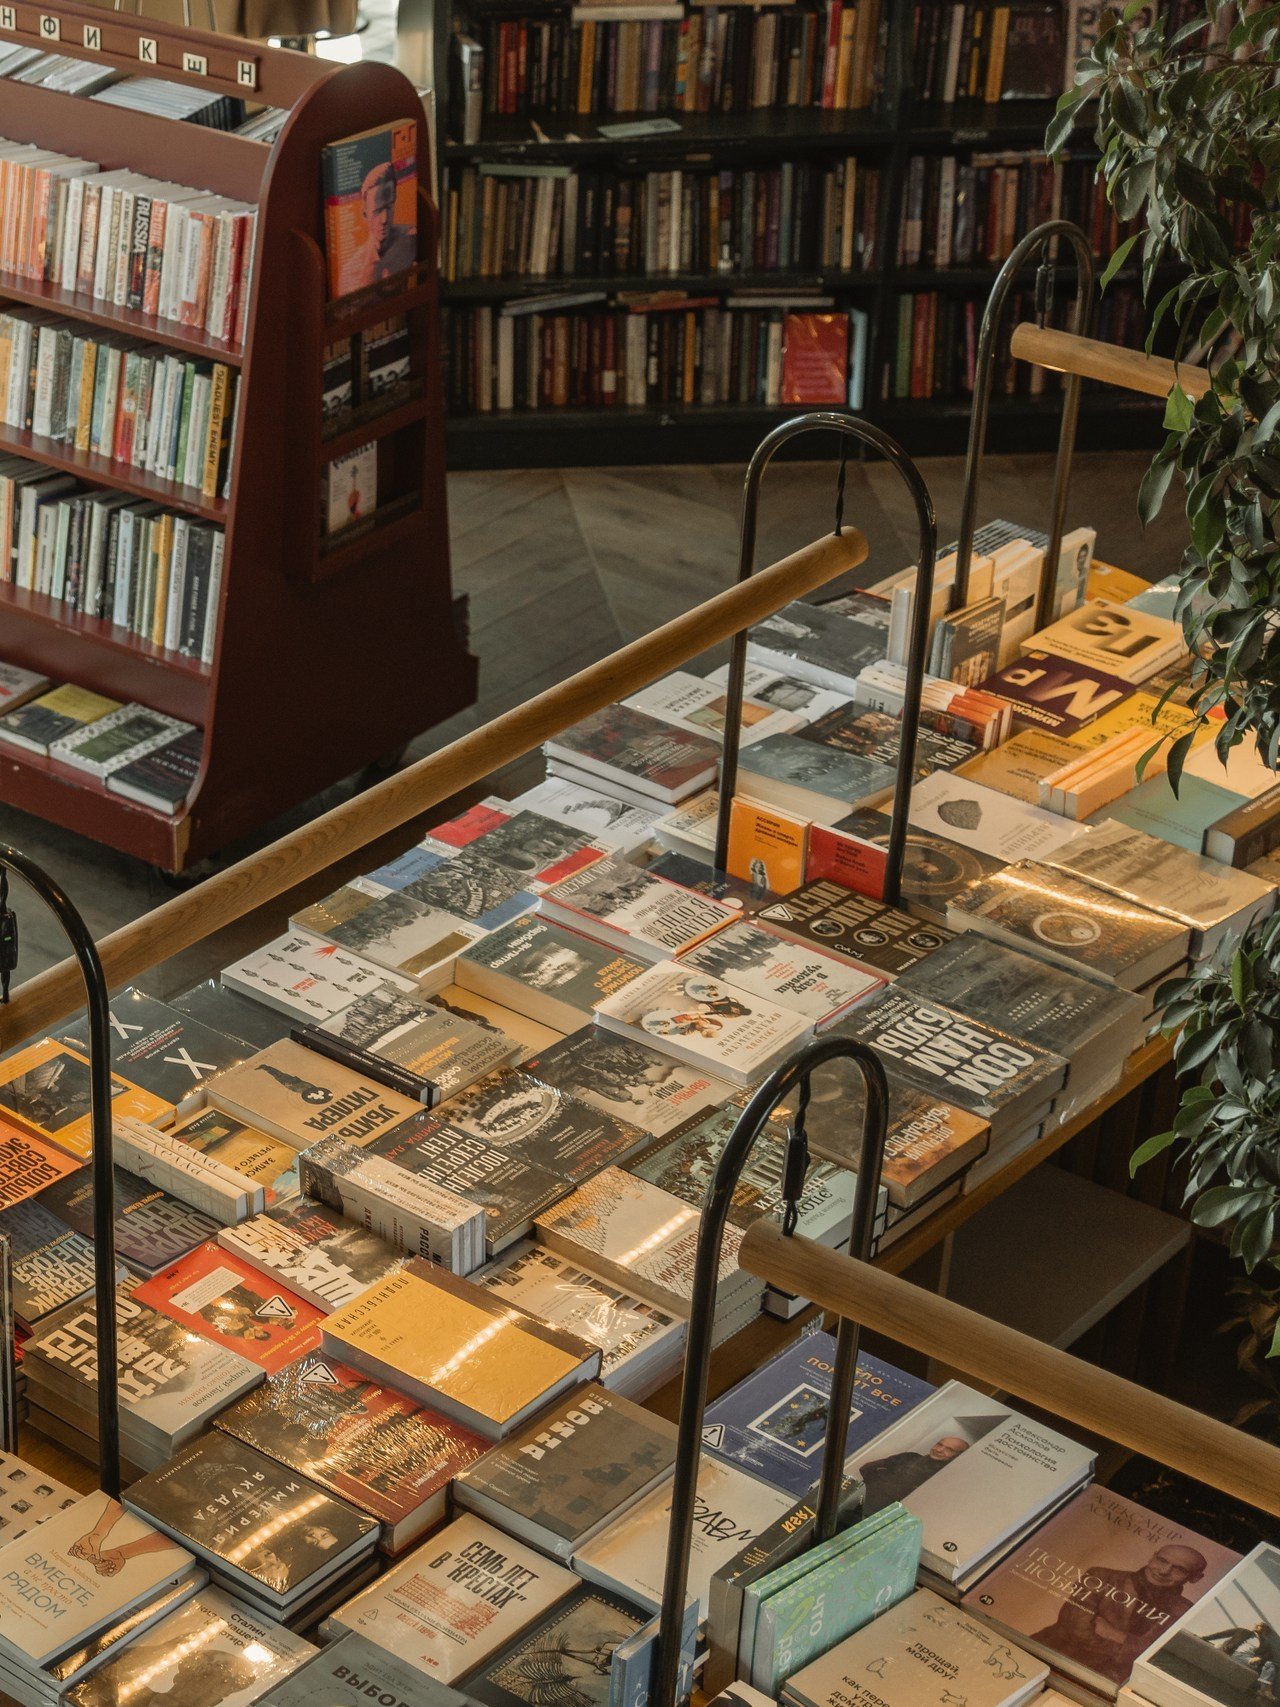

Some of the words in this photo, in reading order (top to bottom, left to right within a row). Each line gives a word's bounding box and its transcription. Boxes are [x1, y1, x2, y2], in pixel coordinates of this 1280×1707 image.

[132, 197, 150, 253] RUSSIA
[212, 366, 228, 426] DEADLIEST
[208, 428, 220, 467] ENEMY
[925, 731, 951, 747] ЗА
[926, 739, 978, 767] БИТВА
[756, 815, 781, 829] АССИРИЯ
[549, 867, 592, 899] ПРЕСТОН
[589, 858, 619, 878] ПОЛ
[632, 903, 655, 920] ФРАНКО
[657, 902, 698, 933] ОГНЕ
[694, 897, 710, 910] В
[509, 923, 548, 950] барбиан
[657, 906, 731, 949] ИСПАНИЯ
[489, 939, 533, 971] ян-питер
[595, 957, 625, 978] рейха
[592, 961, 635, 989] третьего
[601, 965, 646, 993] политика
[773, 963, 823, 995] чудовищ
[793, 977, 819, 996] саду
[716, 1019, 758, 1048] ШПИОНАЖ
[721, 1012, 782, 1057] ПРЕДАТЕЛЬСТВО
[867, 1006, 948, 1060] БУЛЫ
[879, 1012, 908, 1032] Европа
[437, 1036, 494, 1070] освенцима
[460, 1039, 502, 1068] оркестр
[466, 1045, 510, 1075] женский
[903, 1022, 995, 1078] НАМ
[441, 1076, 462, 1093] энн
[945, 1042, 1035, 1098] СОМ
[653, 1079, 685, 1101] ЛЮДИ
[667, 1078, 712, 1107] ОБЫЧНЫЕ
[301, 1086, 381, 1132] ГИТЛЕРА
[338, 1103, 401, 1139] УБИТЬ
[404, 1121, 442, 1145] ПИППА
[415, 1127, 458, 1160] АГЕНТ
[883, 1107, 951, 1161] «БАРБАРОСС
[903, 1126, 956, 1162] ОПЕРАЦИЯ
[240, 1144, 276, 1168] ТРЕТЬЕГО
[418, 1137, 487, 1184] СЕКРЕТН
[441, 1148, 510, 1195] ПОСЛЕДН
[797, 1190, 833, 1221] ЭПОХ
[12, 1233, 89, 1284] ШЕГОСЯ
[25, 1264, 96, 1315] НЕВНИК
[334, 1275, 410, 1331] ПОДНЕБЕСНАЯ
[191, 1383, 223, 1409] Ланьков
[220, 1366, 252, 1392] Андрей
[588, 1391, 614, 1409] ОТЕЛЬ
[869, 1386, 903, 1408] ВСЕ
[520, 1398, 609, 1461] ВОЙНА
[1007, 1425, 1051, 1455] Асмолов
[1013, 1422, 1067, 1457] Александр
[993, 1434, 1059, 1474] достоинства
[1000, 1431, 1059, 1468] Психология
[192, 1470, 267, 1524] ЯКУДЗА
[212, 1479, 302, 1547] ИМПЕРИЯ
[1085, 1501, 1162, 1546] АСМОЛОВ
[1094, 1493, 1184, 1542] АЛЕКСАНДР
[23, 1550, 96, 1609] ВМЕСТЕ,
[428, 1550, 445, 1570] В
[444, 1558, 527, 1610] "КРЕСТАХ"
[458, 1540, 505, 1582] СЕМЬ
[500, 1558, 541, 1591] ЛЕТ
[1, 1570, 67, 1621] РЯДОМ
[41, 1577, 74, 1608] просто
[1016, 1561, 1094, 1605] ЛЮБВИ
[1026, 1546, 1172, 1629] ПСИХОЛОГИЯ
[230, 1611, 268, 1639] Сталин
[809, 1592, 827, 1637] что
[904, 1645, 933, 1664] мой
[925, 1654, 959, 1684] друг
[913, 1641, 962, 1676] прощай,
[841, 1674, 866, 1693] как
